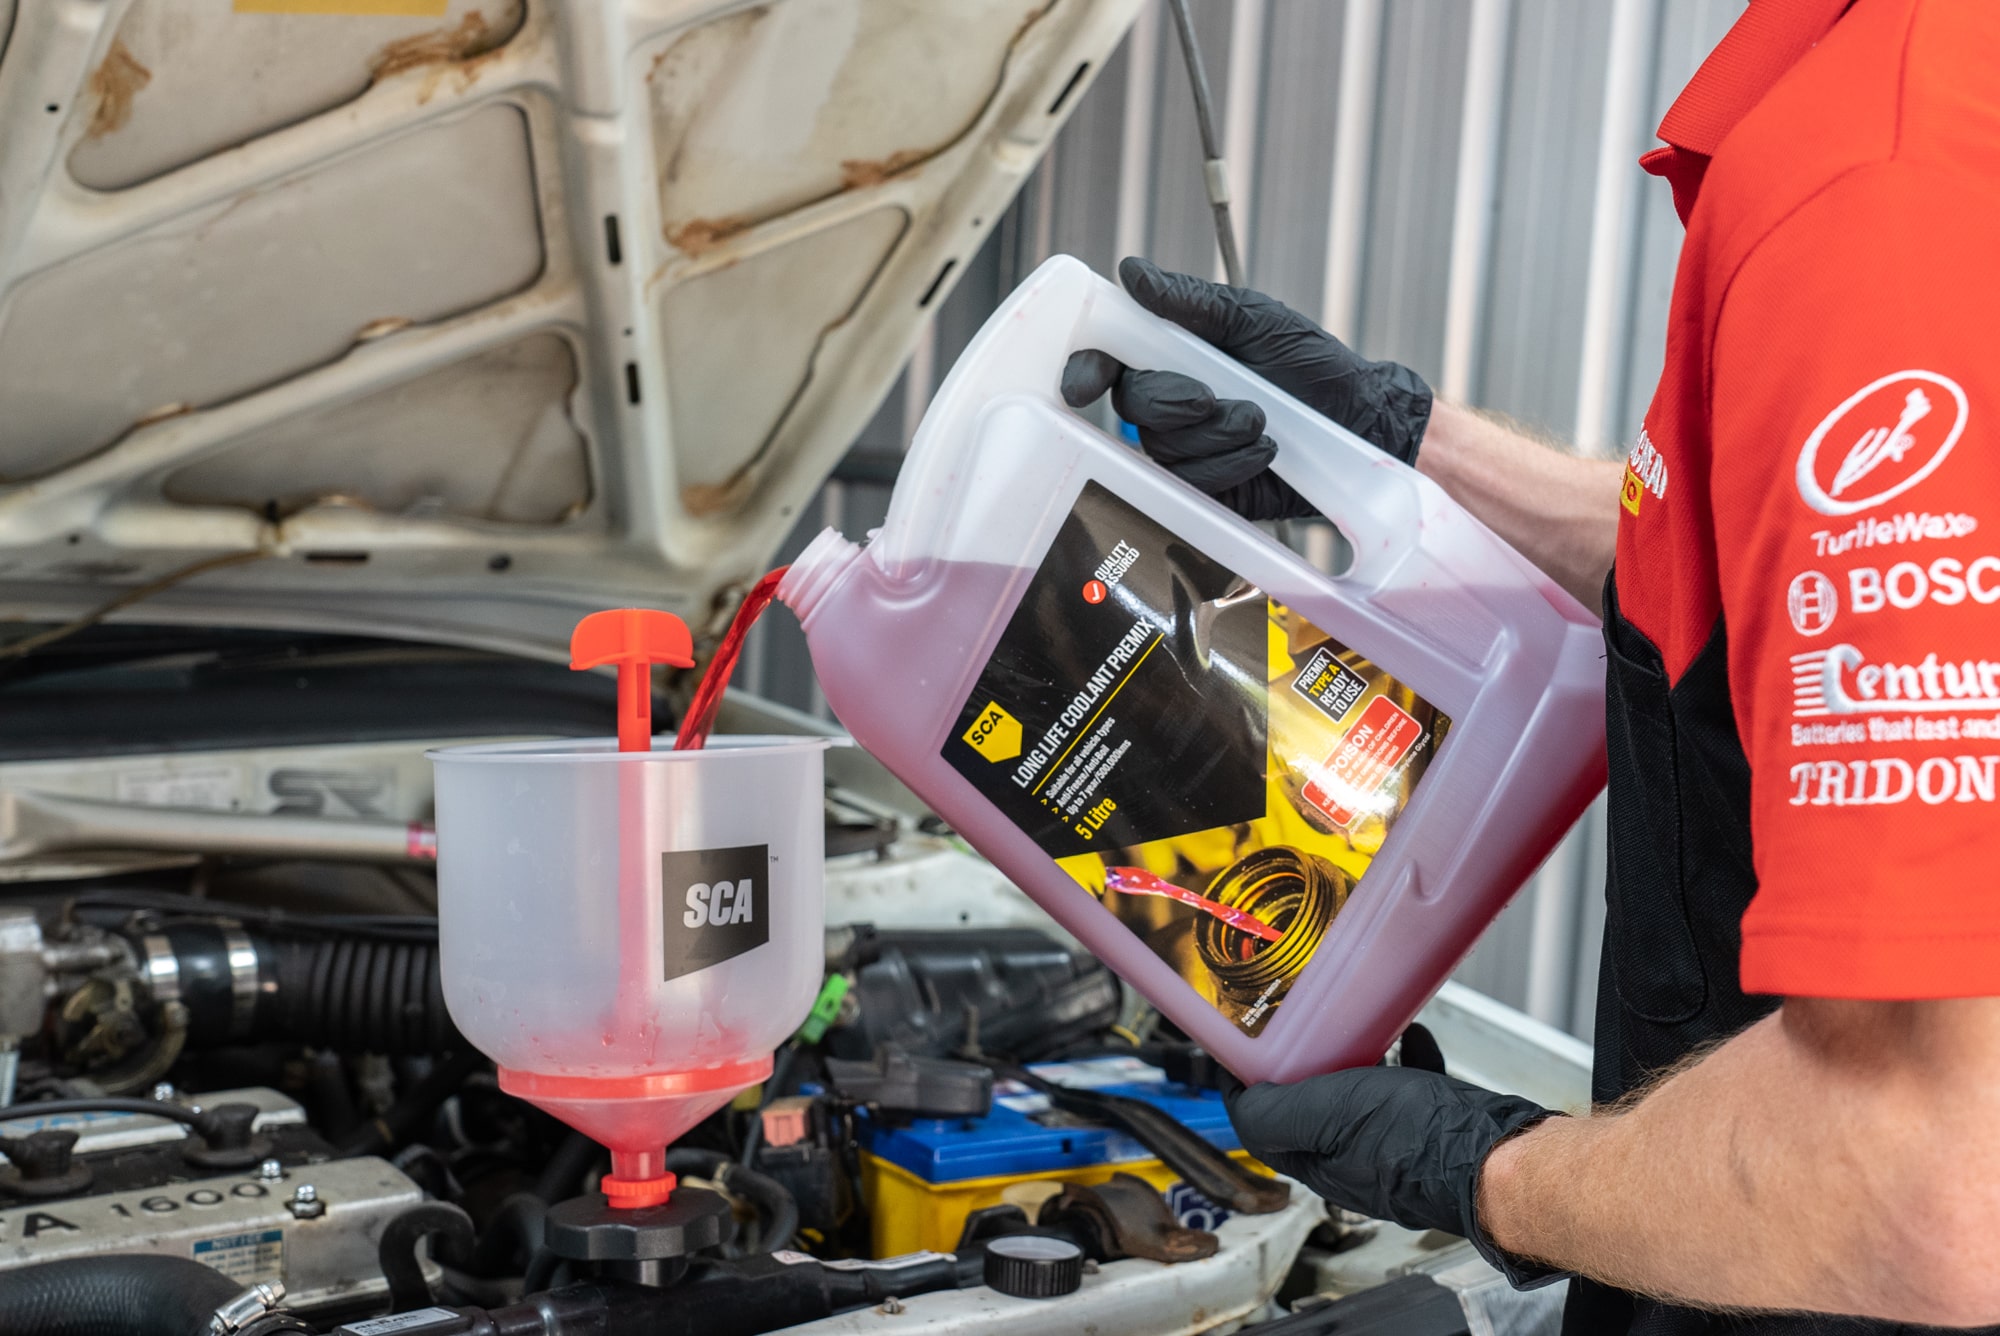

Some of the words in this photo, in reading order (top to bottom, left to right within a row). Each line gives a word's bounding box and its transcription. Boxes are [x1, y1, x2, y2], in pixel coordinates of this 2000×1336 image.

[1092, 538, 1131, 582] QUALITY
[1103, 546, 1141, 589] ASSURED
[1298, 653, 1330, 690] PREMIX
[1308, 670, 1333, 698] TYPE
[1326, 661, 1340, 675] A
[1318, 670, 1351, 707] READY
[1010, 747, 1048, 789] LONG
[1037, 721, 1069, 755] LIFE
[1058, 663, 1116, 729] COOLANT
[1105, 615, 1155, 671] PREMIX
[1330, 697, 1348, 716] TO
[1340, 679, 1363, 703] USE
[968, 707, 1003, 746] SCA
[1366, 739, 1377, 750] OF
[1373, 711, 1399, 741] CHILDREN
[1386, 716, 1407, 742] BEFORE
[1413, 731, 1432, 753] Glycol
[1868, 716, 1913, 742] that
[1914, 715, 1960, 740] last
[1044, 770, 1070, 799] Suitable
[1063, 762, 1077, 776] for
[1070, 754, 1083, 767] all
[1077, 732, 1101, 759] vehicle
[1095, 715, 1117, 739] types
[1327, 722, 1374, 777] POISON
[1381, 743, 1400, 765] USING
[1078, 790, 1088, 800] 7
[1789, 755, 2000, 806] TRIDON
[1065, 802, 1080, 817] Up
[1072, 795, 1084, 807] to
[1082, 793, 1118, 831] Litre
[1073, 822, 1094, 841] 5
[683, 879, 753, 929] SCA
[111, 1183, 269, 1217] 1600
